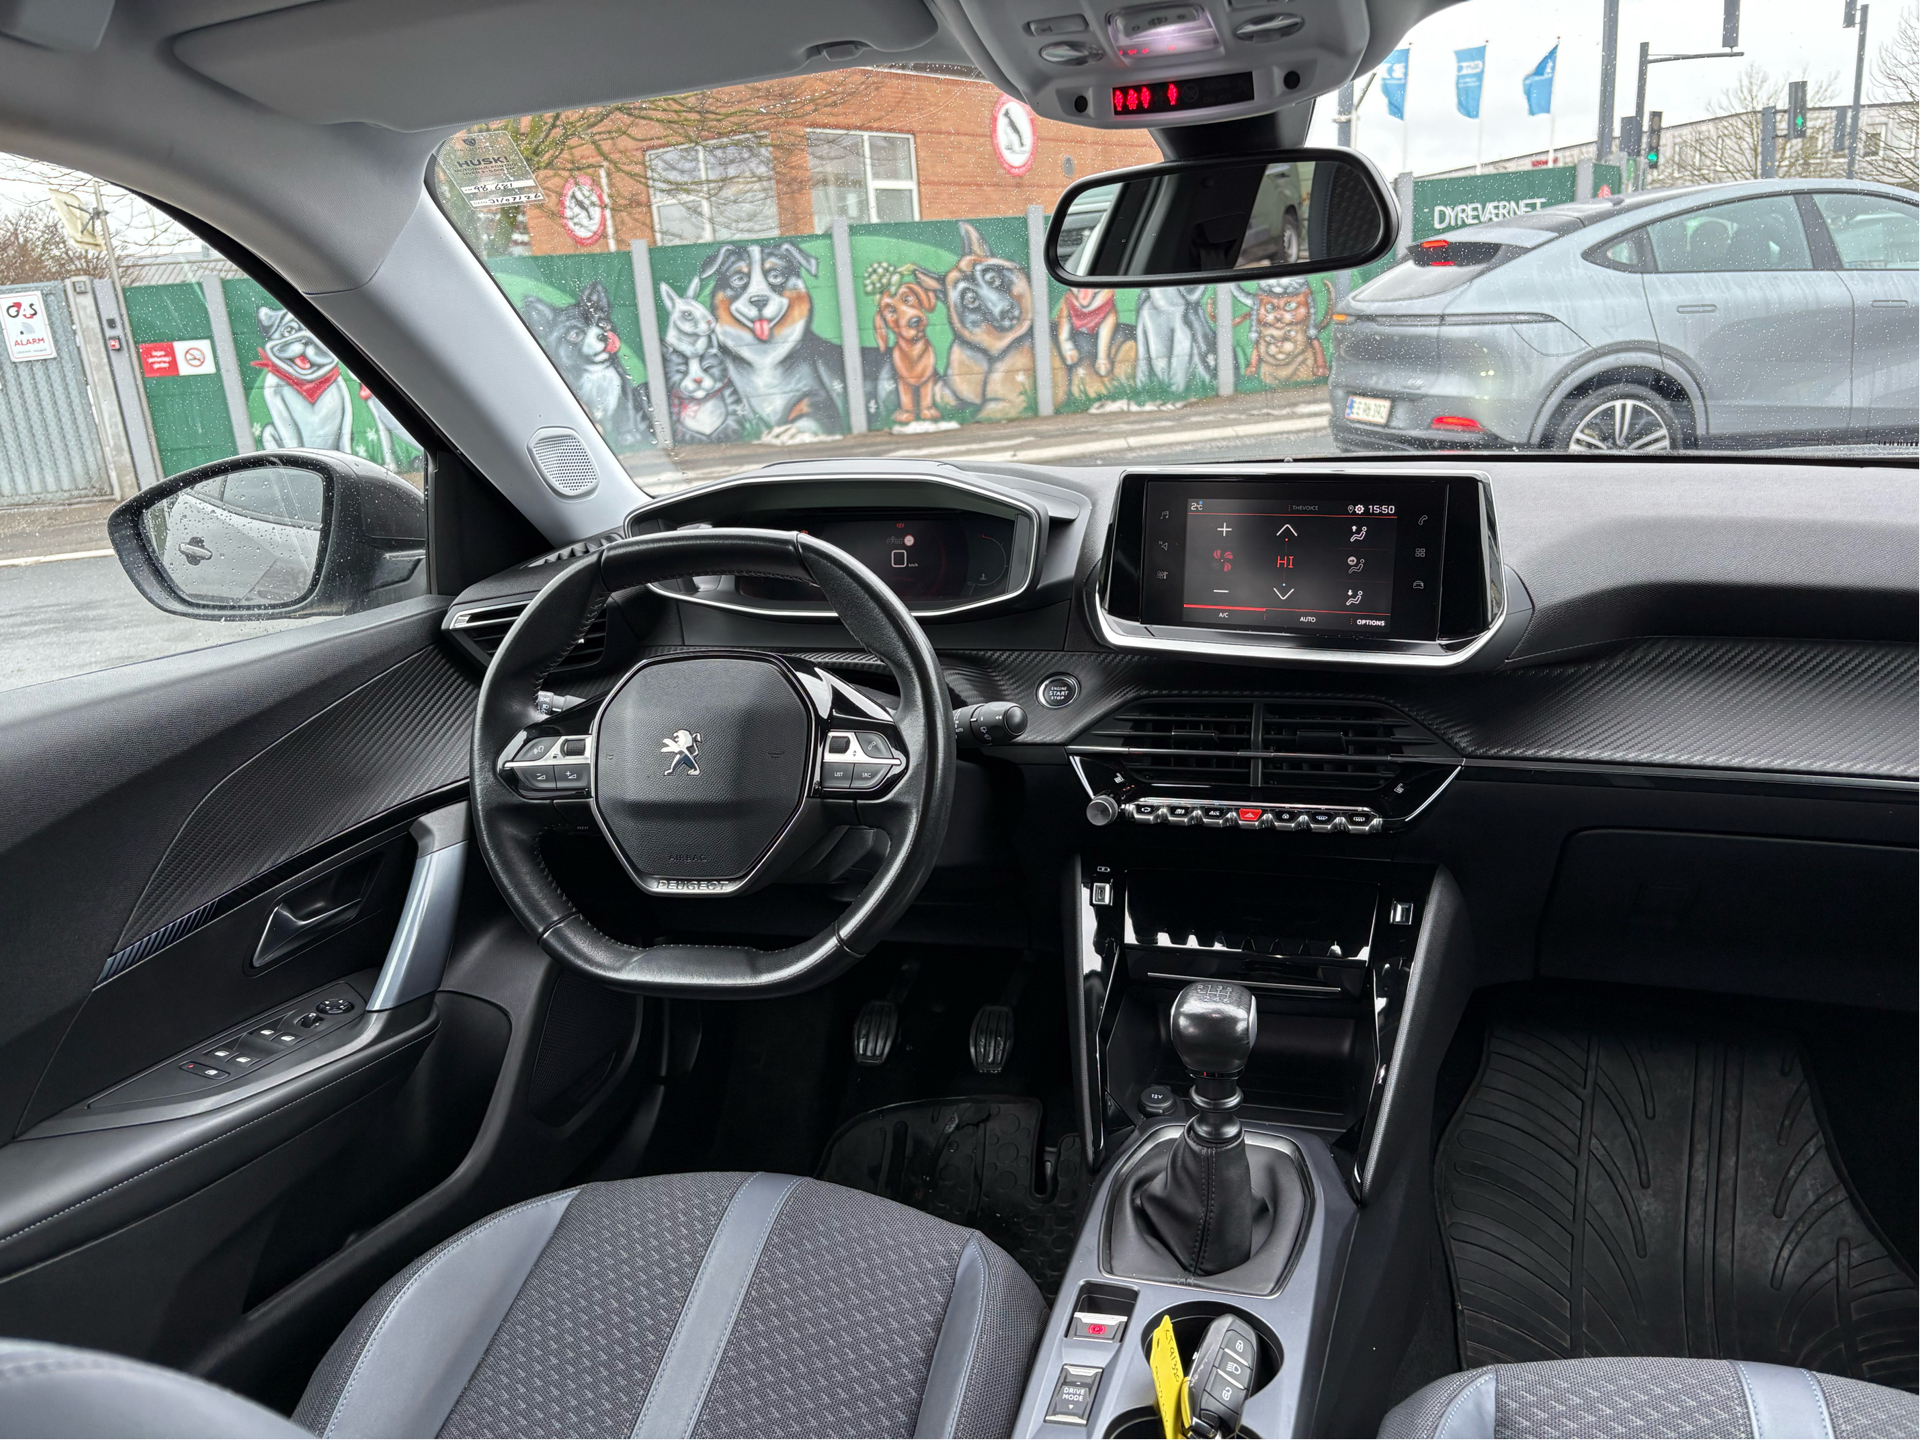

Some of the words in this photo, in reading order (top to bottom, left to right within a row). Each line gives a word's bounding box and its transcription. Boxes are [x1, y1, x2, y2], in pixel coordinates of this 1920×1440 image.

[1434, 198, 1548, 230] DYREVÆRNET
[14, 337, 46, 347] ALARM
[1368, 504, 1396, 514] 15:50
[1276, 555, 1294, 569] HI
[1299, 615, 1316, 623] AUTO
[1356, 618, 1386, 627] OPTIONS
[667, 853, 708, 863] AIRBAG
[656, 880, 729, 891] PEUGEOT
[1063, 1387, 1086, 1396] DRIVE
[1062, 1393, 1084, 1402] MODE
